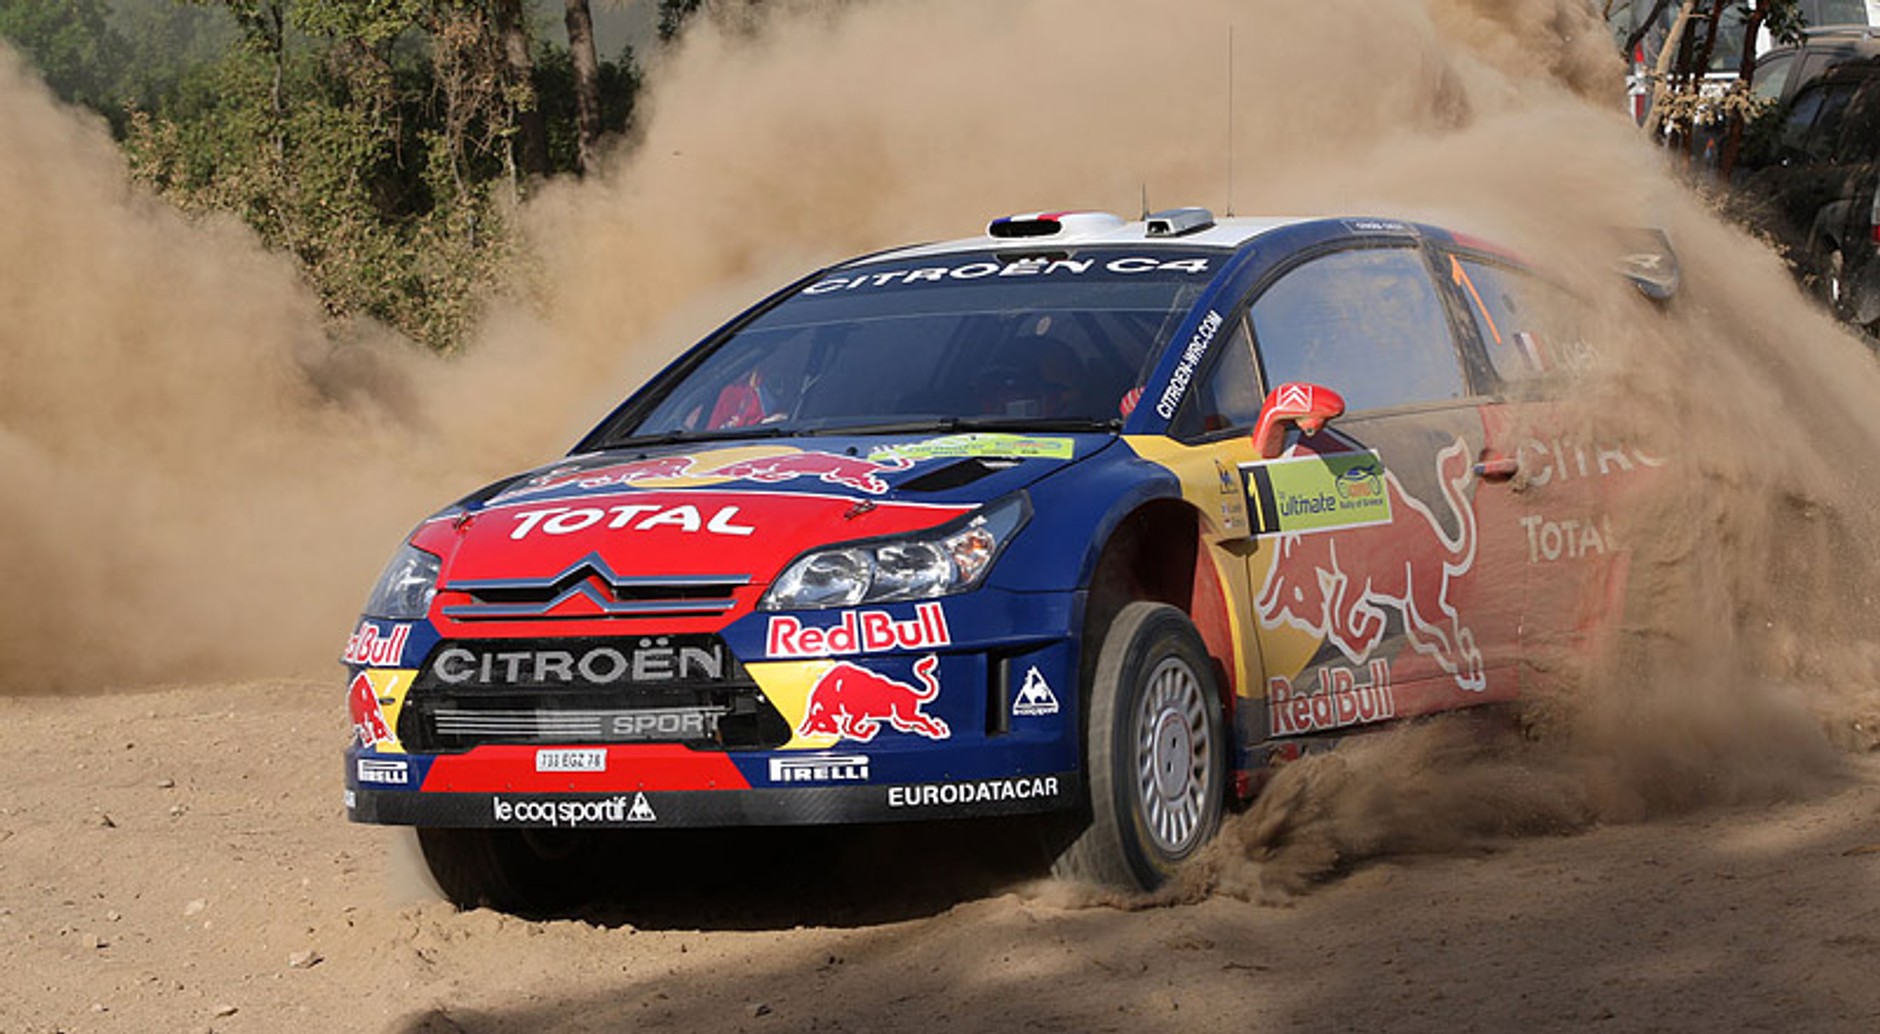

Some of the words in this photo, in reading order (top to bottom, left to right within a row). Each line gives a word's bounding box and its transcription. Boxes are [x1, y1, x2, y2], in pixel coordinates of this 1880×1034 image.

[802, 257, 1095, 294] CITROËN
[1106, 258, 1210, 274] C4
[1449, 254, 1502, 345] 1
[1156, 309, 1223, 419] CITROEN-WRC.COM
[1247, 472, 1266, 533] 1
[1280, 491, 1337, 517] ultimate
[510, 504, 756, 540] TOTAL
[357, 626, 409, 664] Bull
[767, 611, 858, 656] Red
[861, 603, 949, 651] Bull
[432, 636, 723, 684] CITROËN
[1270, 670, 1334, 736] Red
[1333, 660, 1395, 726] Bull
[612, 711, 728, 735] SPORT
[768, 755, 869, 782] PIRELLI
[887, 776, 1059, 807] EURODATACAR
[493, 796, 513, 821] le
[514, 801, 558, 828] coq
[557, 796, 627, 828] sportif
